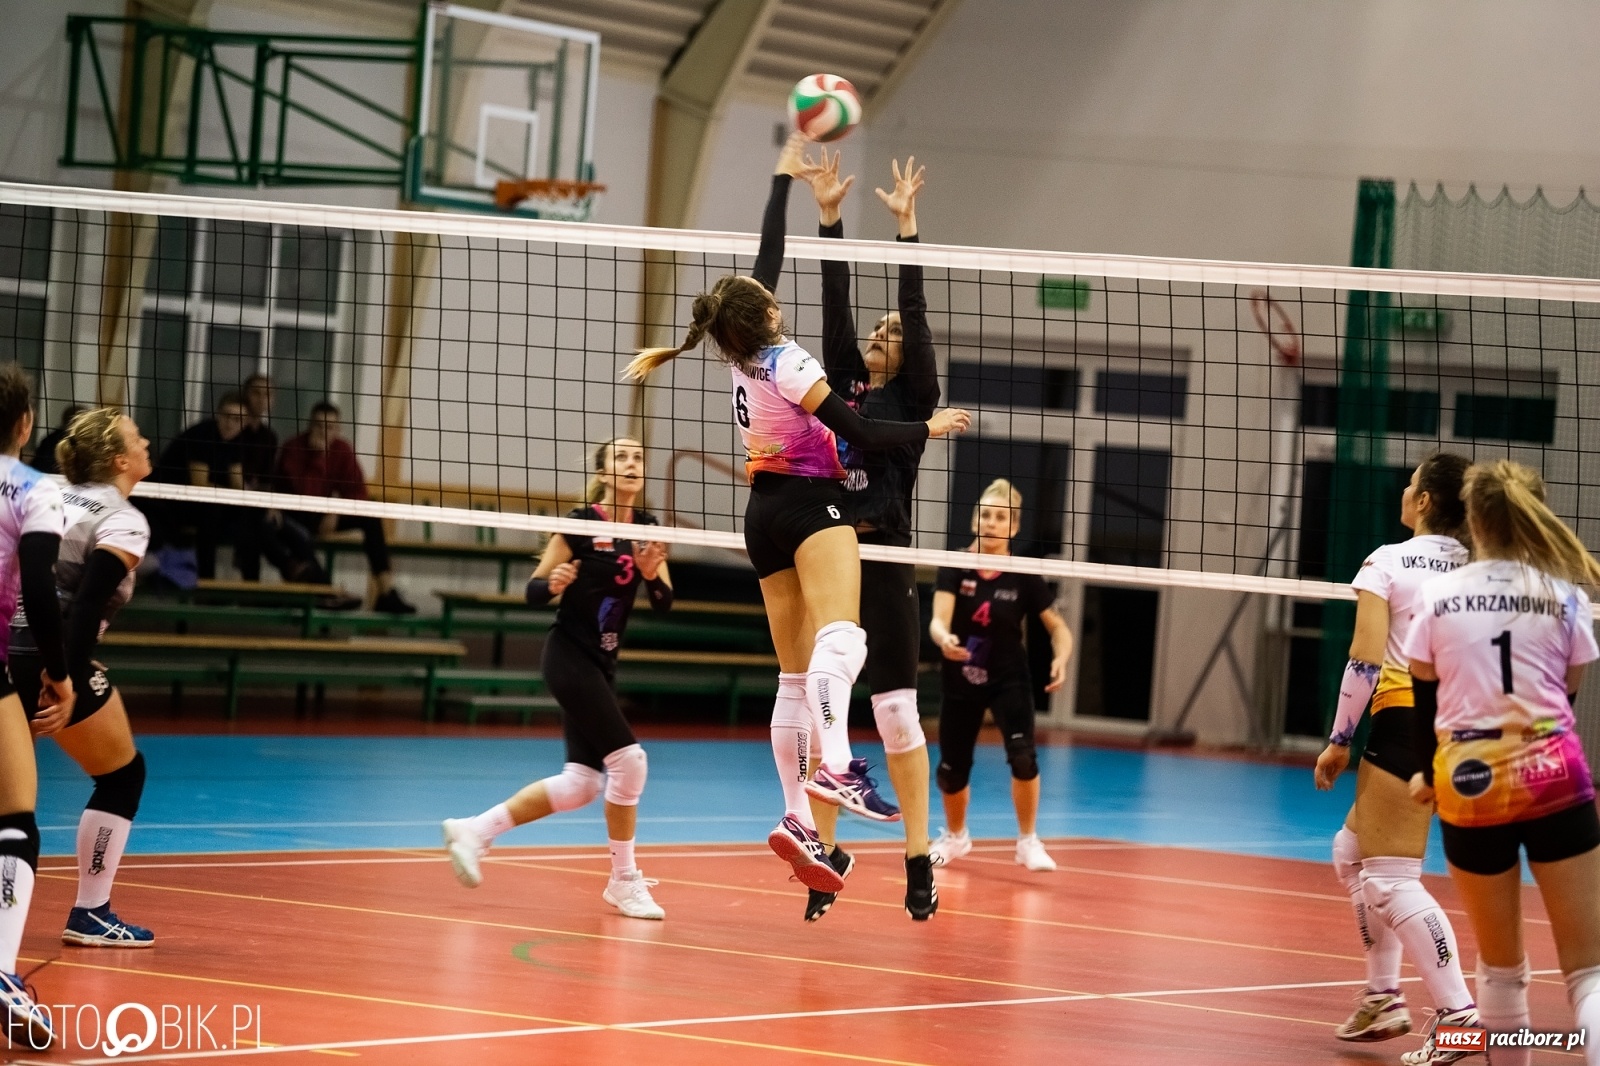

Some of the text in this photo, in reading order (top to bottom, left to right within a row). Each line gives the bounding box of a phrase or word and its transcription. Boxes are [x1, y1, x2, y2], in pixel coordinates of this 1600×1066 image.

[748, 365, 772, 381] WICE
[736, 385, 750, 428] 6
[826, 505, 841, 519] 6
[614, 554, 634, 586] 3
[1401, 555, 1427, 569] UKS
[971, 600, 991, 627] 4
[1434, 594, 1569, 621] UKS KRZANOWICE
[1490, 630, 1514, 694] 1
